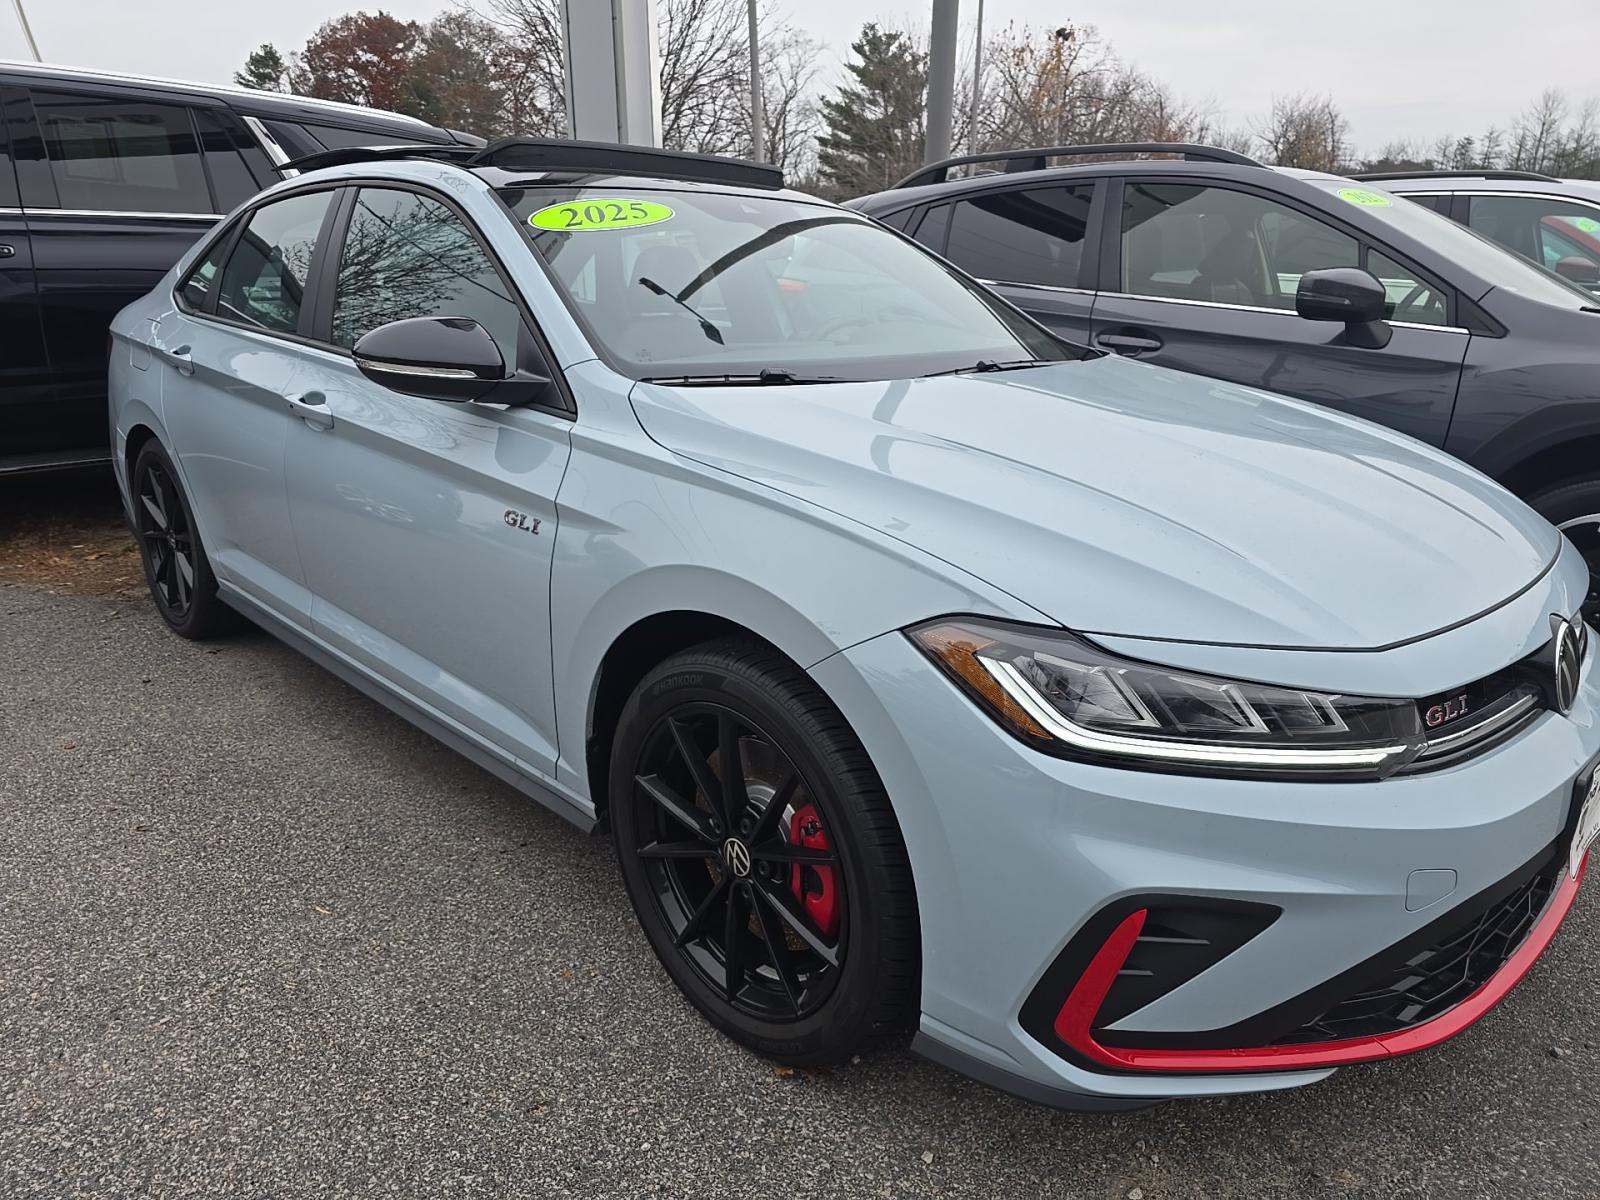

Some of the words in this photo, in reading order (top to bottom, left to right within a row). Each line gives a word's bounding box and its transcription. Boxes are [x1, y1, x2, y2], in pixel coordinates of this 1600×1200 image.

[559, 203, 649, 227] 2025
[503, 509, 542, 536] GLI
[1425, 694, 1468, 727] GLI
